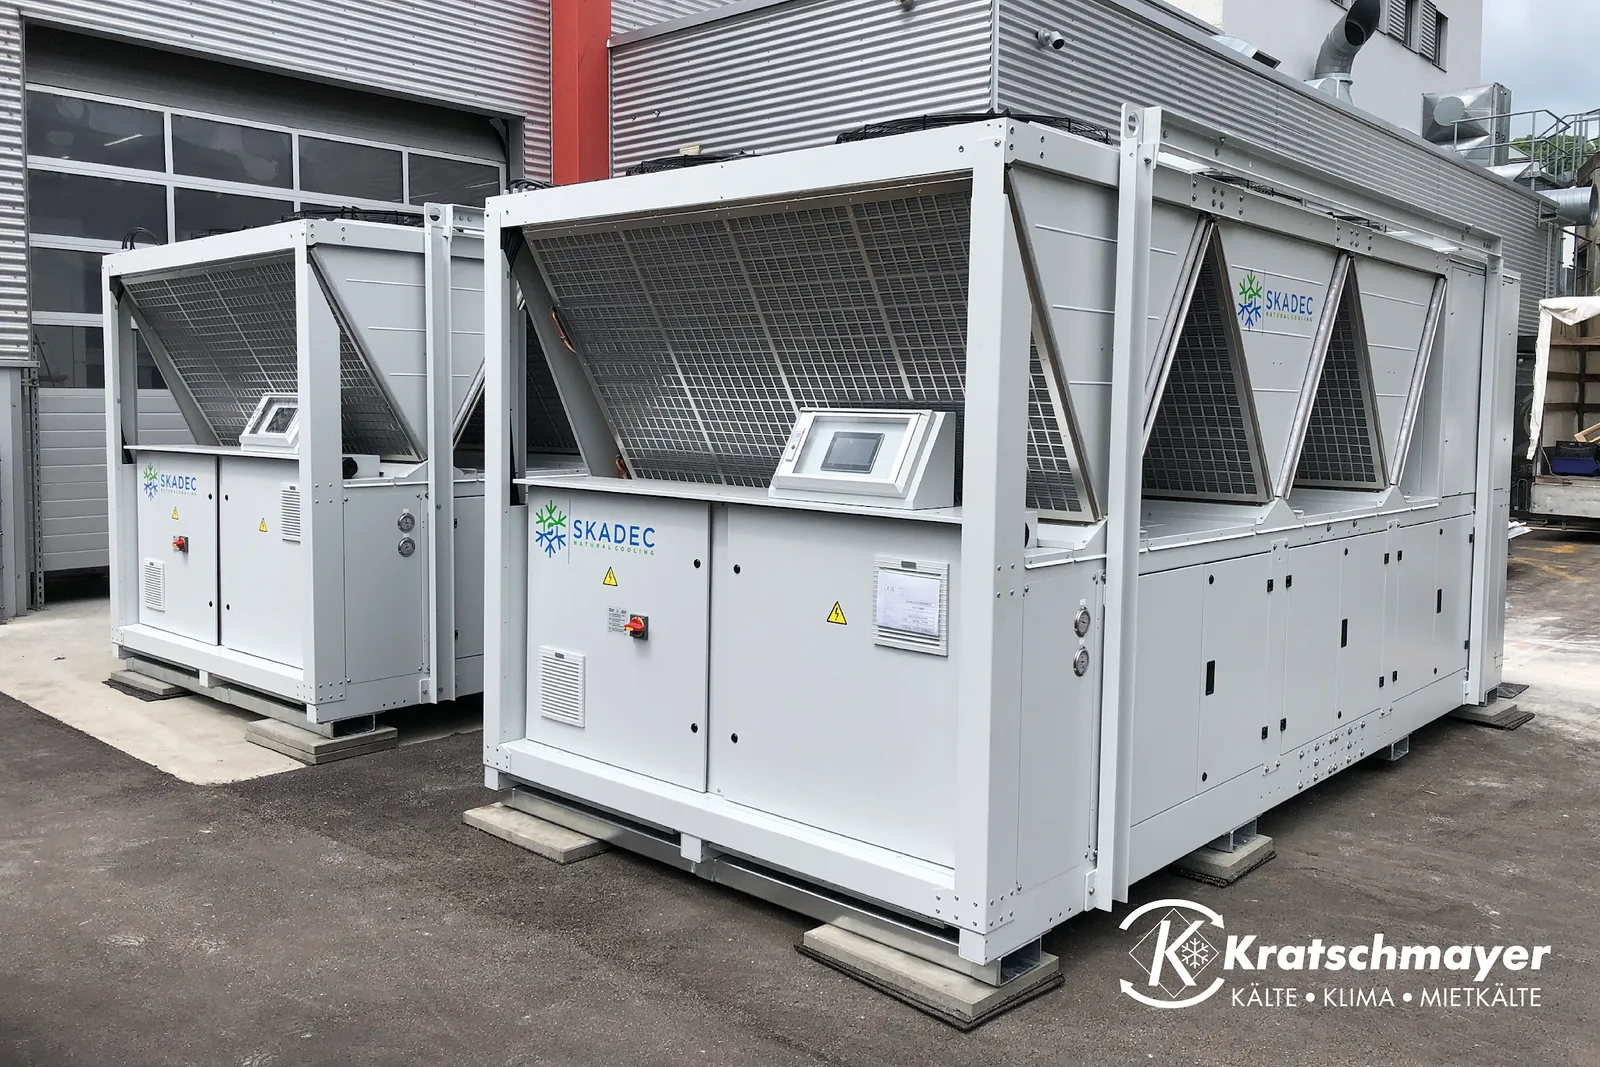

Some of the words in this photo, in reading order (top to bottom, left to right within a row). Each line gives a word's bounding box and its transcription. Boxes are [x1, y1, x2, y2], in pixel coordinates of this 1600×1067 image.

[1265, 290, 1314, 315] SKADEC
[160, 474, 197, 491] SKADEC
[573, 519, 656, 548] SKADEC
[573, 540, 612, 551] NATURAL
[614, 545, 655, 556] COOLING
